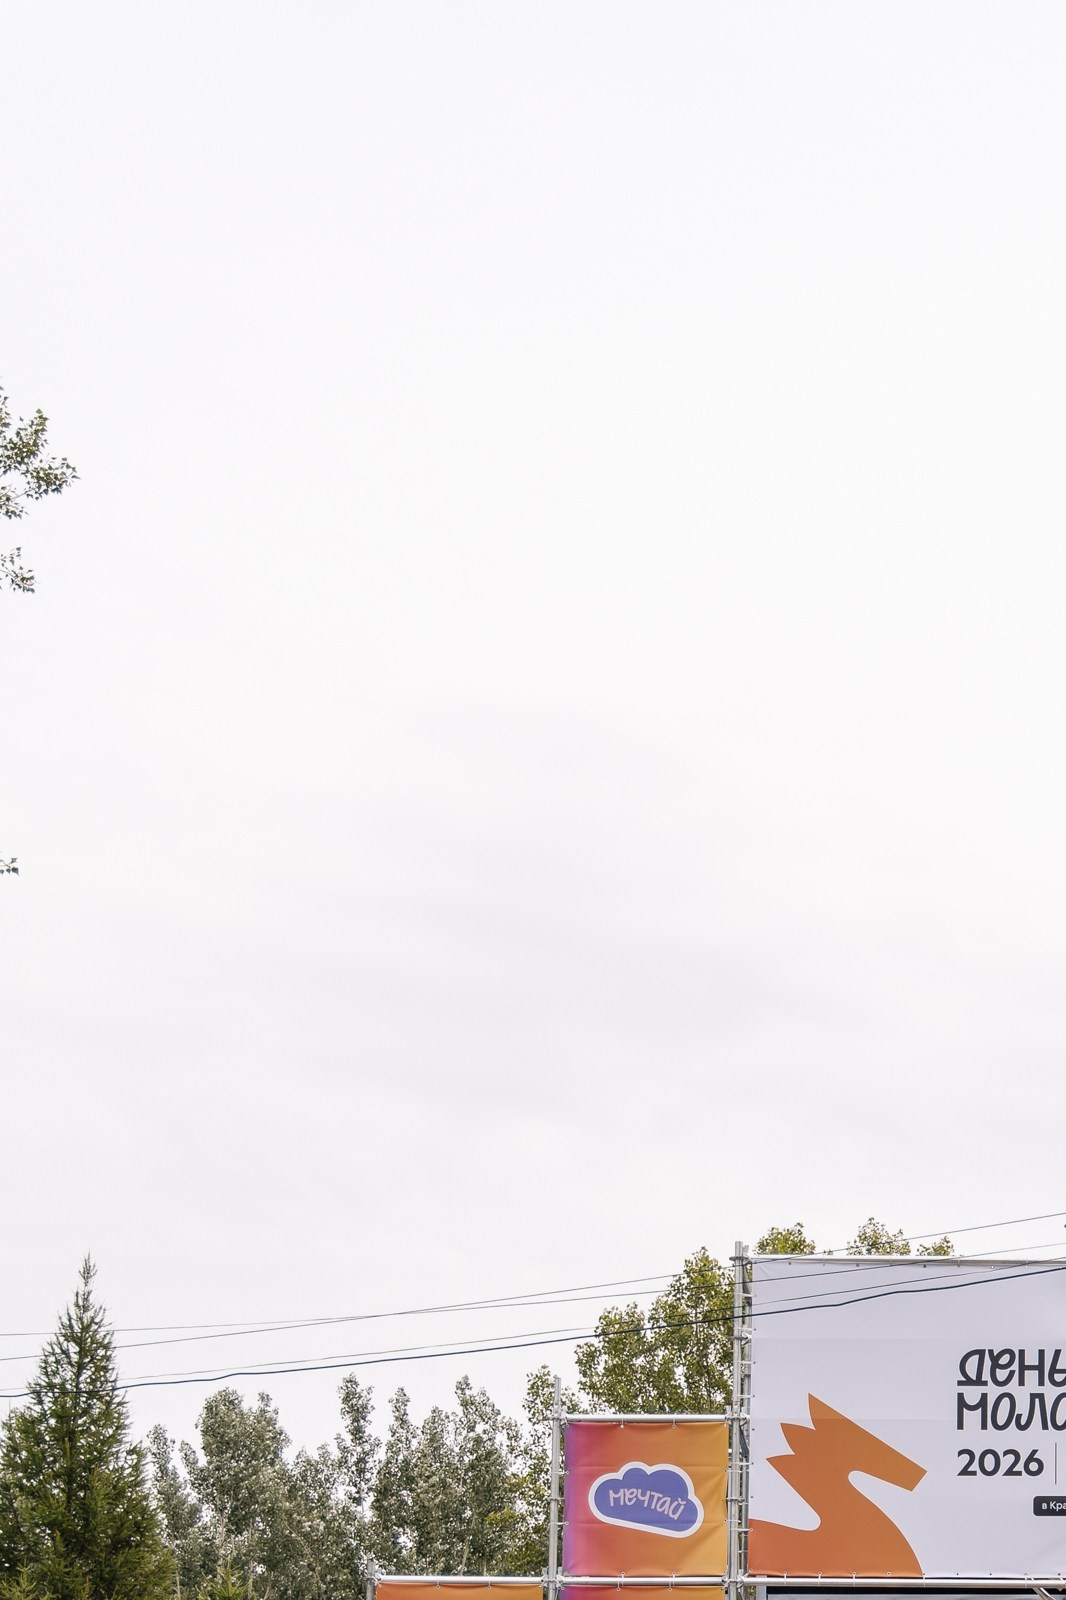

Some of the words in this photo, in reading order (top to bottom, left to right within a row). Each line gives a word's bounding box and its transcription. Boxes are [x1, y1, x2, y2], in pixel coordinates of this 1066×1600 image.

[957, 1449, 1044, 1477] 2026
[608, 1488, 687, 1521] МЕЧТАЙ
[1042, 1502, 1048, 1510] в
